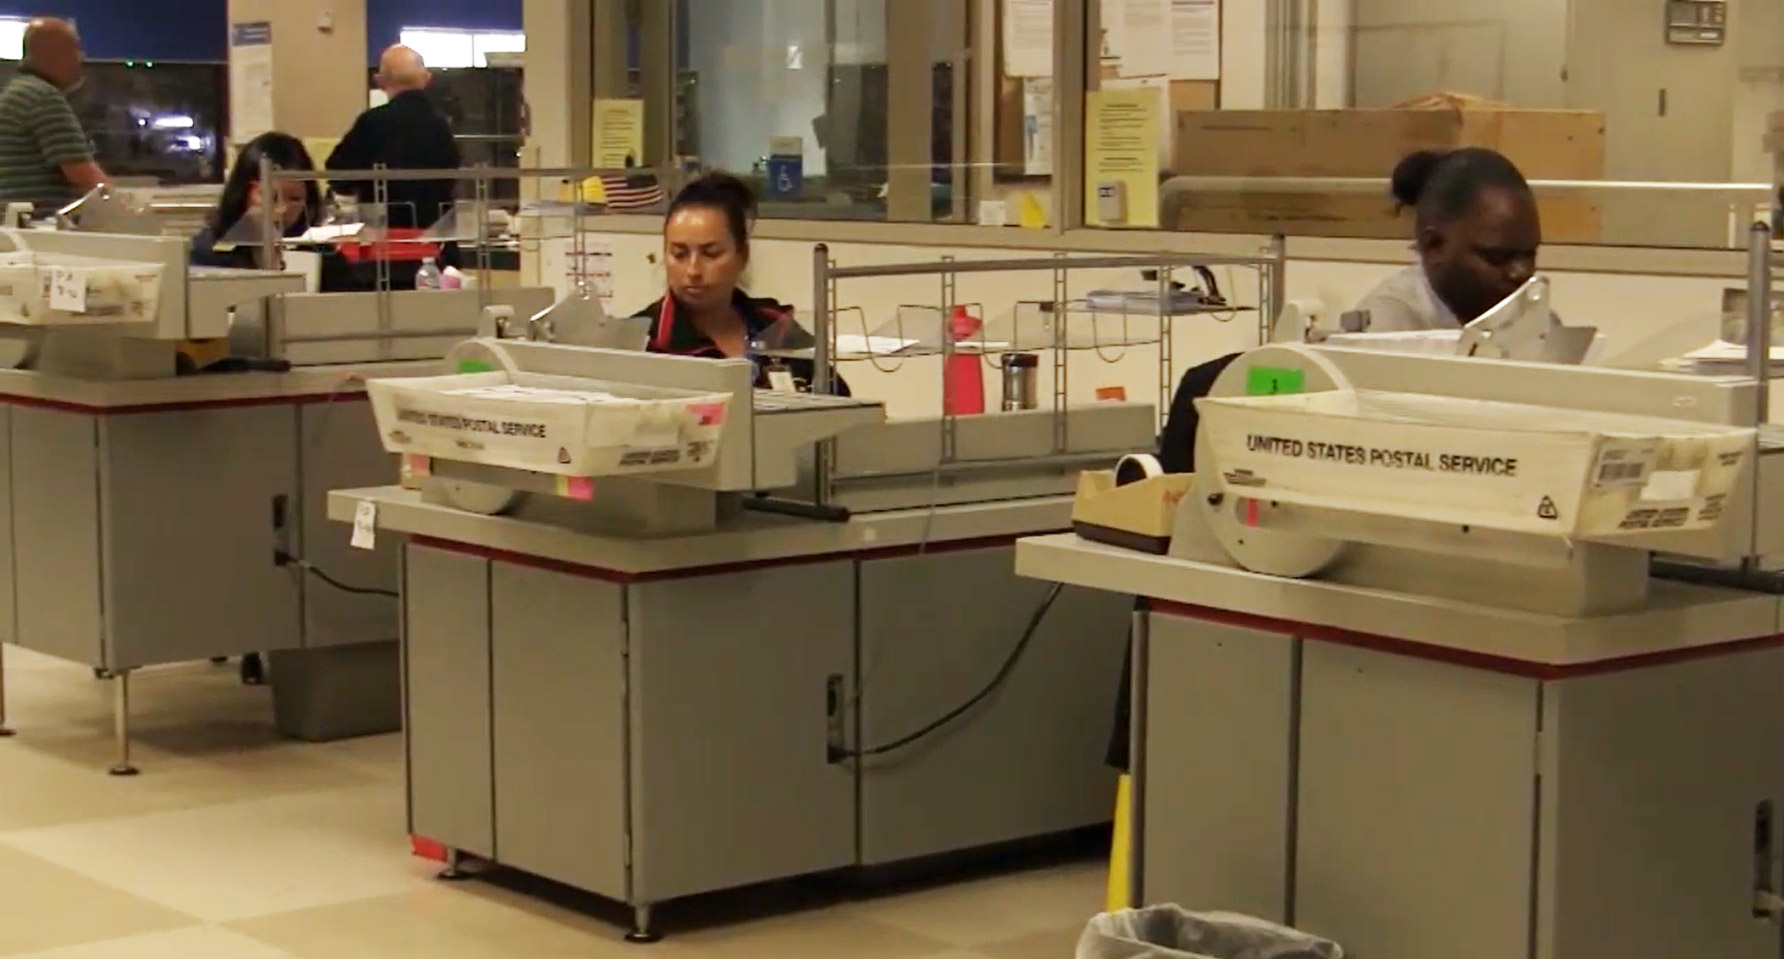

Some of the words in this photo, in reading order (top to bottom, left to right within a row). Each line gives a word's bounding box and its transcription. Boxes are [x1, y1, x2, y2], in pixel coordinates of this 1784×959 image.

[462, 418, 500, 434] POSTAL
[501, 421, 546, 438] SERVICE
[1247, 434, 1302, 457] UNITED
[1306, 441, 1366, 464] STATES
[1370, 449, 1434, 471] POSTAL
[1439, 454, 1517, 477] SERVICE
